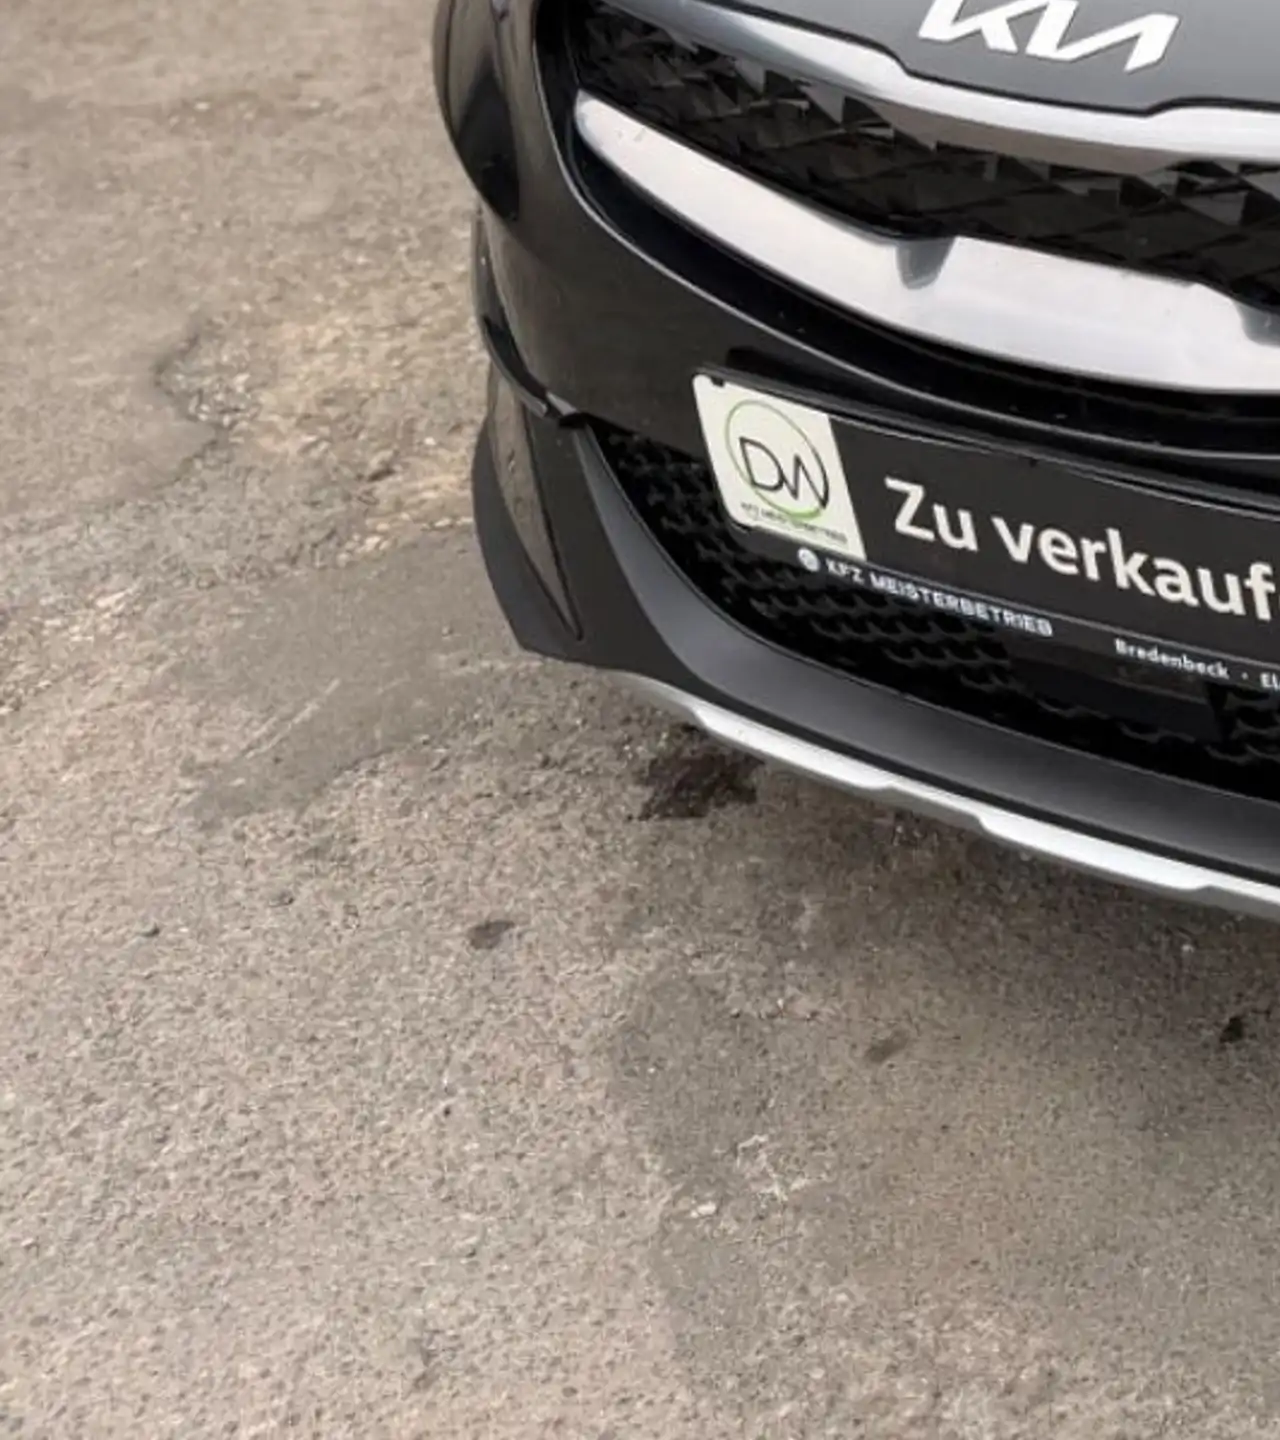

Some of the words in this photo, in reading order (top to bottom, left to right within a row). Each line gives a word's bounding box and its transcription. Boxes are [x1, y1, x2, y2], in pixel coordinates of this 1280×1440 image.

[885, 476, 979, 553] Zu
[825, 558, 865, 585] KFZ
[869, 572, 1054, 638] MEISTERBETRIEB
[1113, 637, 1230, 681] Bredenbeck
